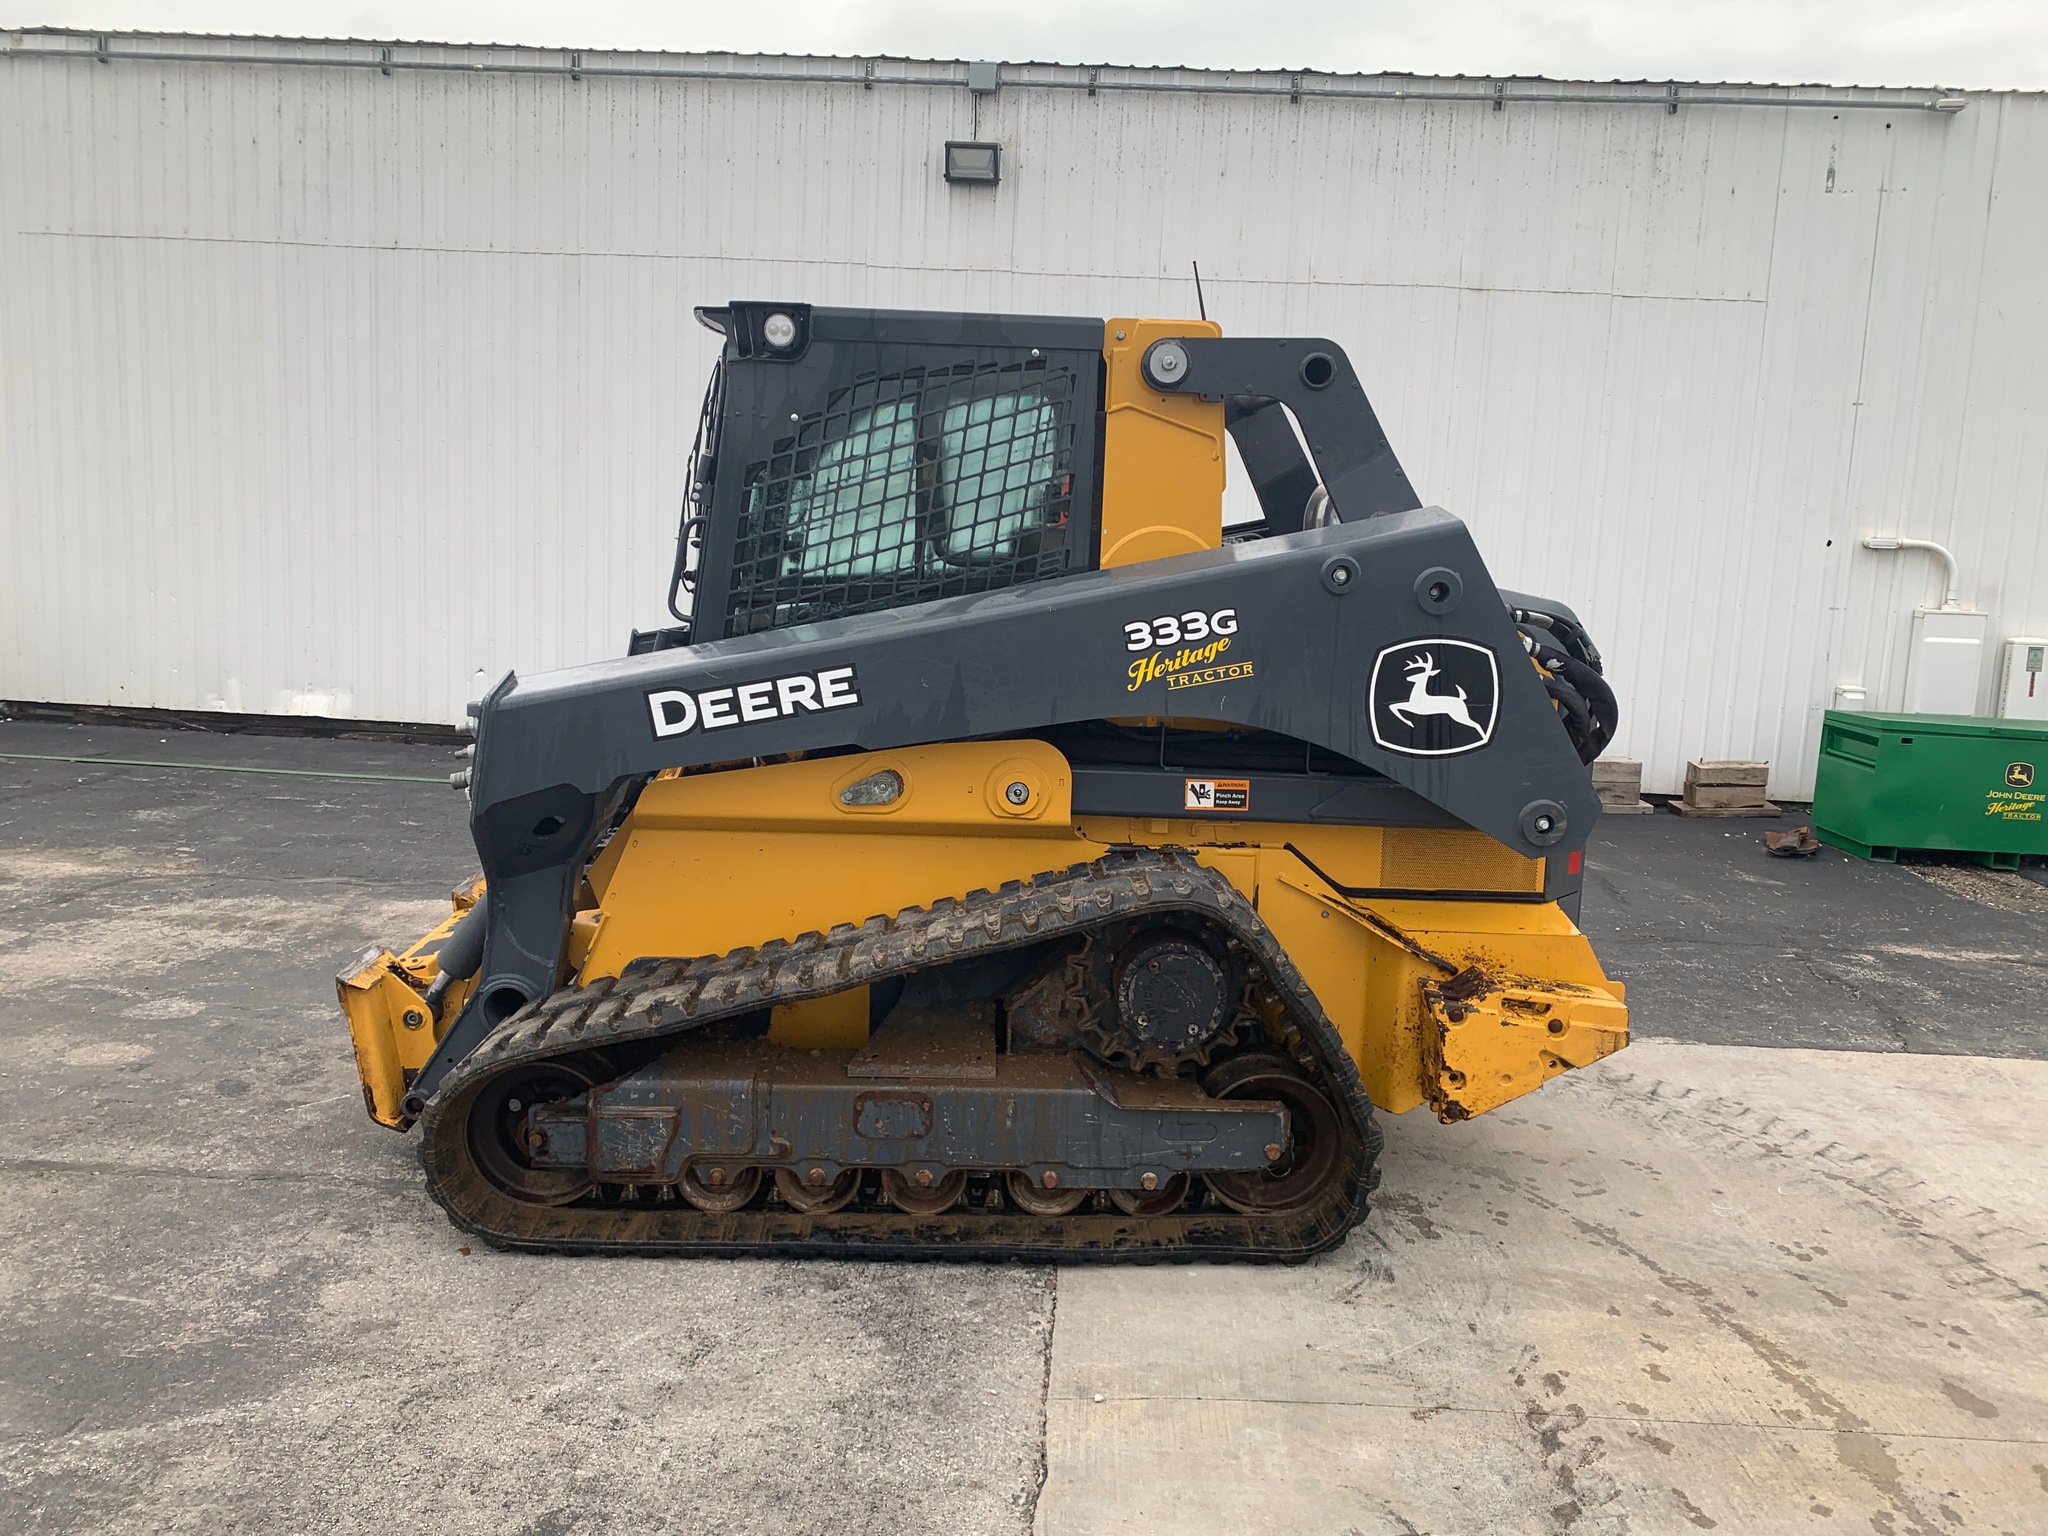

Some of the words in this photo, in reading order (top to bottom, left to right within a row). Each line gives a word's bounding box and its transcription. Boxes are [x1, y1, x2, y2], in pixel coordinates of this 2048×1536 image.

[1124, 609, 1238, 651] 333G
[1127, 637, 1232, 692] Heritage
[1166, 664, 1253, 687] TRACTOR
[648, 667, 858, 737] DEERE
[1986, 790, 2013, 799] JOHN
[2014, 792, 2046, 801] DEERE
[1985, 801, 2035, 815] Heritage
[2003, 812, 2041, 820] TRACTOR
